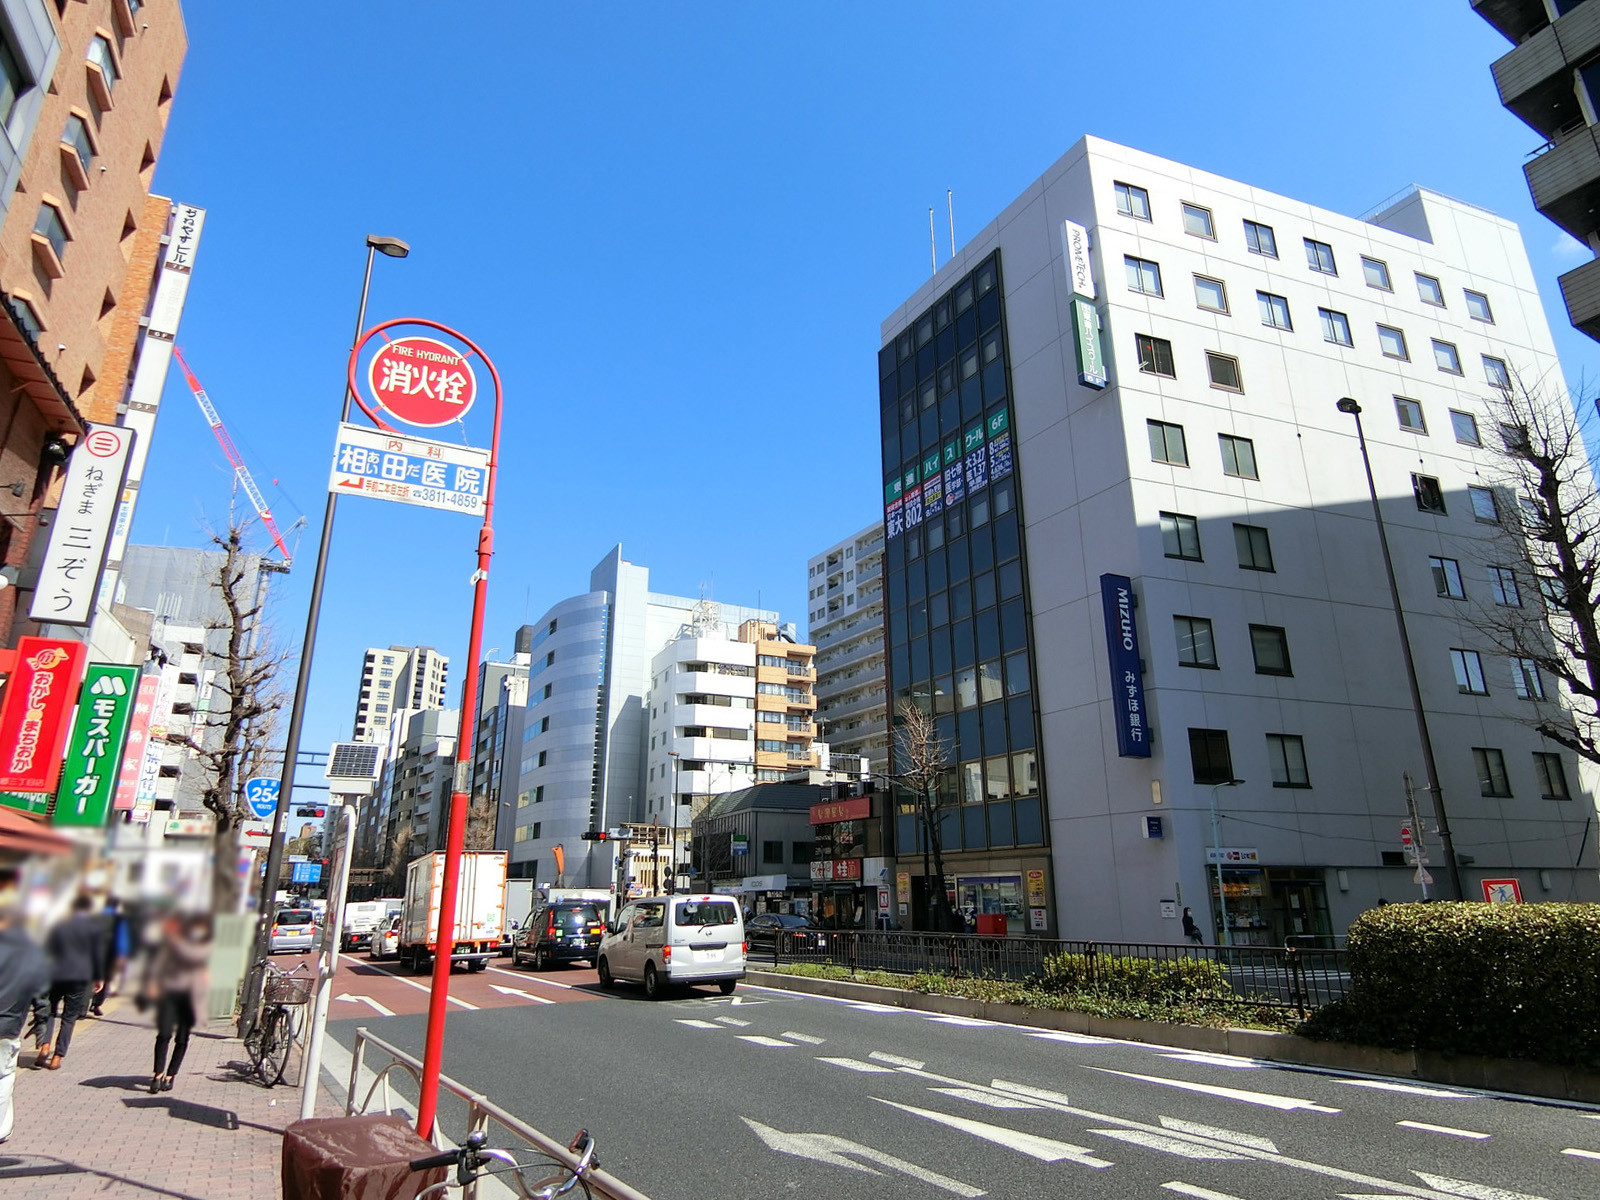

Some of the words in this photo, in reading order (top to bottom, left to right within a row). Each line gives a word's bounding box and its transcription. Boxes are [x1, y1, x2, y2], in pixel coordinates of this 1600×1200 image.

[392, 345, 414, 357] FIRE
[416, 350, 460, 366] HYDRANT
[380, 358, 468, 404] 消火栓
[992, 414, 1004, 430] 6F
[388, 440, 442, 458] 内科
[78, 466, 104, 516] ねぎま
[422, 488, 477, 508] 3811-4859
[52, 526, 92, 614] 三ぞう
[1117, 587, 1134, 652] MIZUHO
[1124, 670, 1142, 742] みずほ銀行
[74, 698, 117, 815] モスバーガー
